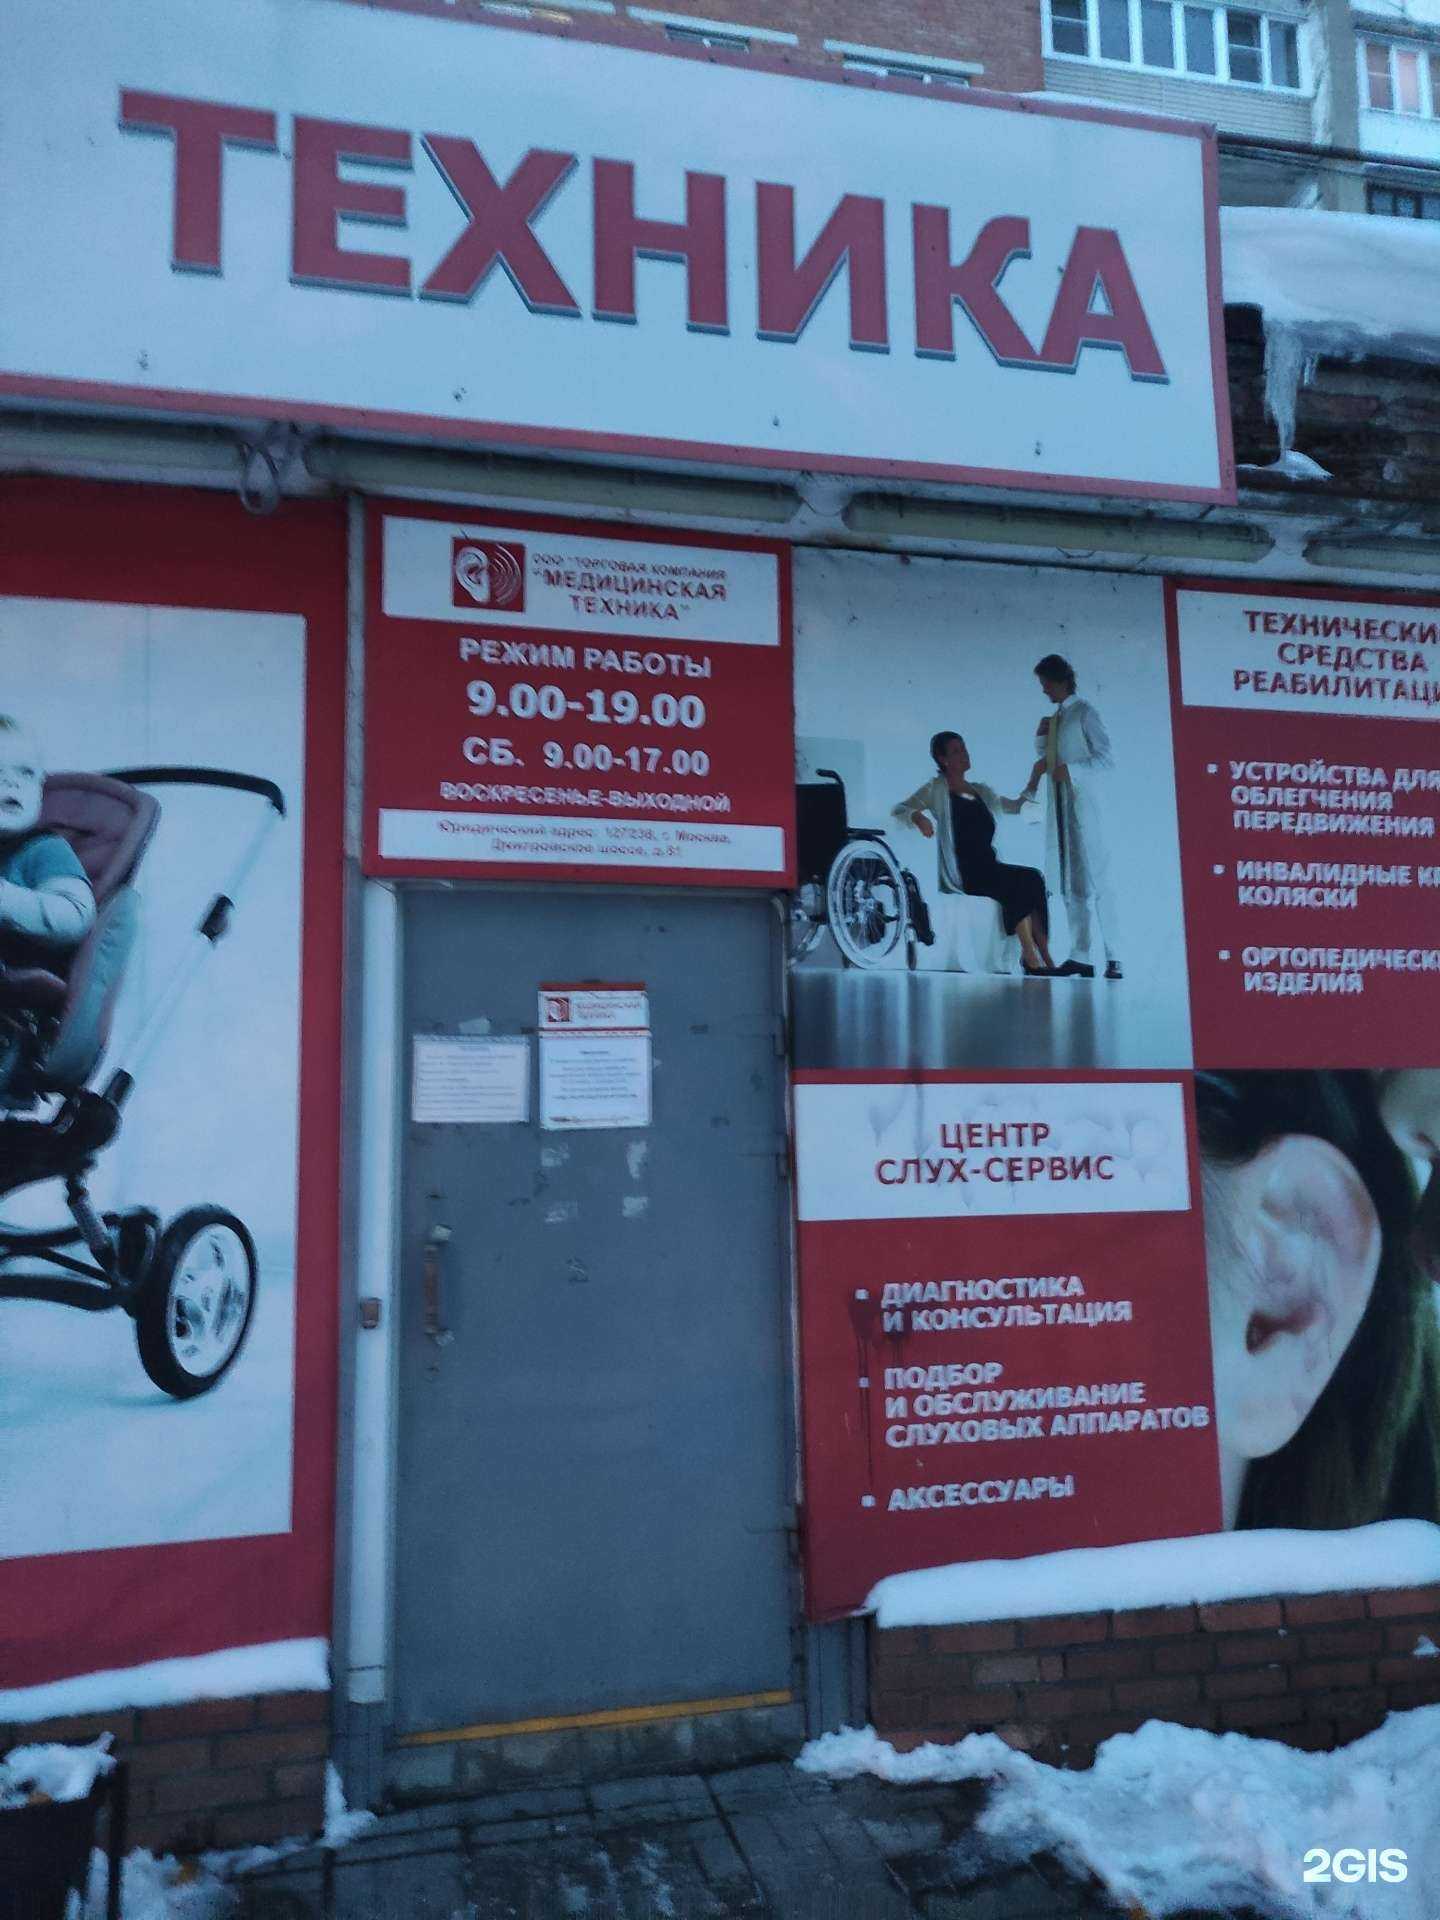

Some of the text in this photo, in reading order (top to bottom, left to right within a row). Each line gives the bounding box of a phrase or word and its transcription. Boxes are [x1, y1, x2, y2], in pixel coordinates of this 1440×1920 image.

[118, 86, 1170, 385] ТЕХНИКА
[1243, 610, 1440, 645] ТЕХНИЧЕСКИ
[459, 637, 711, 679] РЕЖИМ РАБОТЫ
[1277, 642, 1428, 672] СРЕДСТВА
[466, 680, 706, 729] 9.00-19.00
[462, 736, 710, 776] СБ. 9.00-17.00
[1228, 759, 1440, 793] УСТРОЙСТВА ДЛЯ
[1231, 785, 1393, 812] ОБЛЕГЧЕНИЯ
[1233, 810, 1435, 837] ПЕРЕДВИЖЕНИЯ
[1236, 861, 1411, 887] ИНВАЛИДНЫЕ
[1238, 886, 1358, 909] КОЛЯСКИ
[1242, 946, 1440, 973] ОРТОПЕДИЧЕСК
[1244, 971, 1363, 996] ИЗДЕЛИЯ
[939, 1122, 1050, 1152] ЦЕНТР
[875, 1154, 1116, 1185] СЛУХ-СЕРВИС
[880, 1275, 1085, 1309] ДИАГНОСТИКА
[883, 1300, 1132, 1333] И КОНСУЛЬТАЦИЯ
[884, 1362, 1004, 1391] ПОДБОР
[885, 1381, 1146, 1419] И ОБСЛУЖИВАНИЕ
[885, 1405, 1210, 1448] СЛУХОВЫХ АППАРАТОВ
[888, 1475, 1074, 1511] АКСЕССУАРЫ
